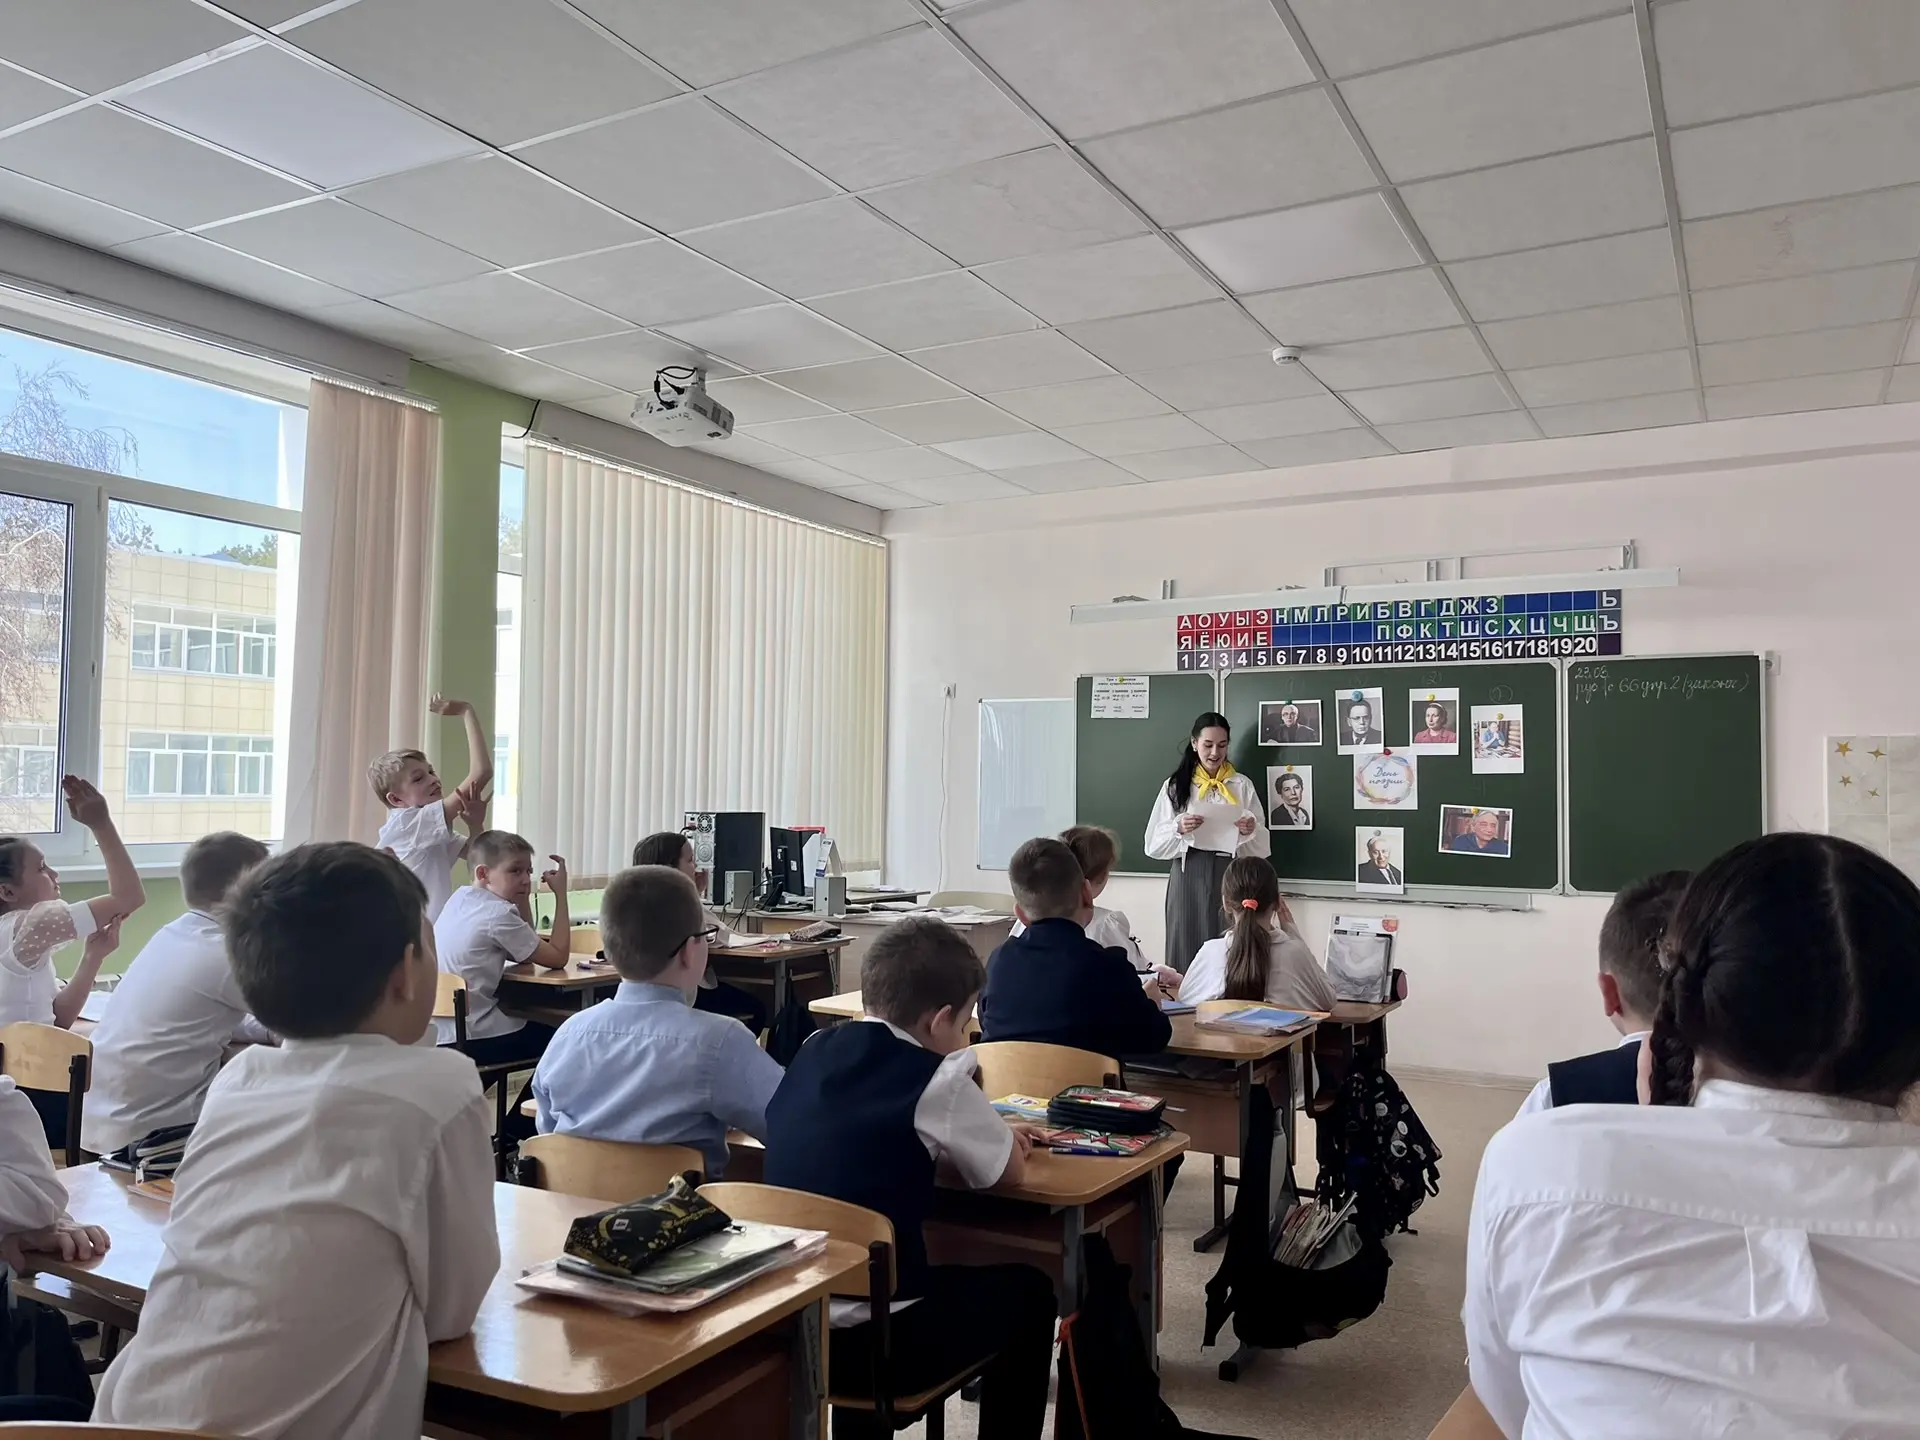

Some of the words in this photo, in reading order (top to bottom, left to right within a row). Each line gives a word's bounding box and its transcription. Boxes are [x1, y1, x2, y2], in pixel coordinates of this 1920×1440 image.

[1180, 616, 1192, 629] А
[1198, 614, 1211, 628] О
[1218, 613, 1229, 627] У
[1236, 612, 1249, 626] Ы
[1256, 611, 1269, 625] Э
[1275, 609, 1288, 624] Н
[1294, 608, 1308, 623] М
[1315, 607, 1328, 622] Л
[1336, 606, 1349, 621] Р
[1357, 605, 1369, 620] И
[1377, 603, 1390, 618] Б
[1398, 602, 1412, 617] В
[1420, 601, 1432, 617] Г
[1440, 600, 1455, 616] Д
[1460, 599, 1479, 614] Ж
[1485, 598, 1499, 613] З
[1602, 591, 1617, 607] Ь
[1180, 635, 1192, 649] Я
[1200, 632, 1210, 648] Ё
[1217, 633, 1230, 648] Ю
[1237, 632, 1249, 646] И
[1256, 631, 1268, 646] Е
[1377, 625, 1390, 640] П
[1396, 624, 1413, 639] Ф
[1420, 623, 1432, 638] К
[1441, 622, 1454, 637] Т
[1460, 620, 1480, 636] Ш
[1484, 619, 1499, 635] С
[1507, 619, 1522, 635] Х
[1530, 616, 1545, 634] Ц
[1553, 616, 1568, 632] Ч
[1574, 615, 1596, 632] Щ
[1598, 614, 1619, 631] Ъ
[1181, 654, 1189, 669] 1
[1199, 653, 1210, 668] 2
[1219, 652, 1229, 667] 3
[1237, 651, 1248, 666] 4
[1256, 650, 1267, 666] 5
[1276, 650, 1287, 665] 6
[1296, 649, 1307, 665] 7
[1316, 648, 1327, 664] 8
[1336, 647, 1348, 663] 9
[1352, 646, 1372, 662] 10
[1374, 645, 1392, 661] 11
[1394, 644, 1415, 661] 12
[1415, 643, 1437, 660] 13
[1437, 642, 1459, 659] 14
[1459, 641, 1481, 658] 15
[1481, 641, 1503, 657] 16
[1504, 640, 1526, 657] 17
[1526, 639, 1549, 656] 18
[1550, 637, 1573, 655] 19
[1573, 636, 1597, 654] 20
[1373, 766, 1399, 777] День
